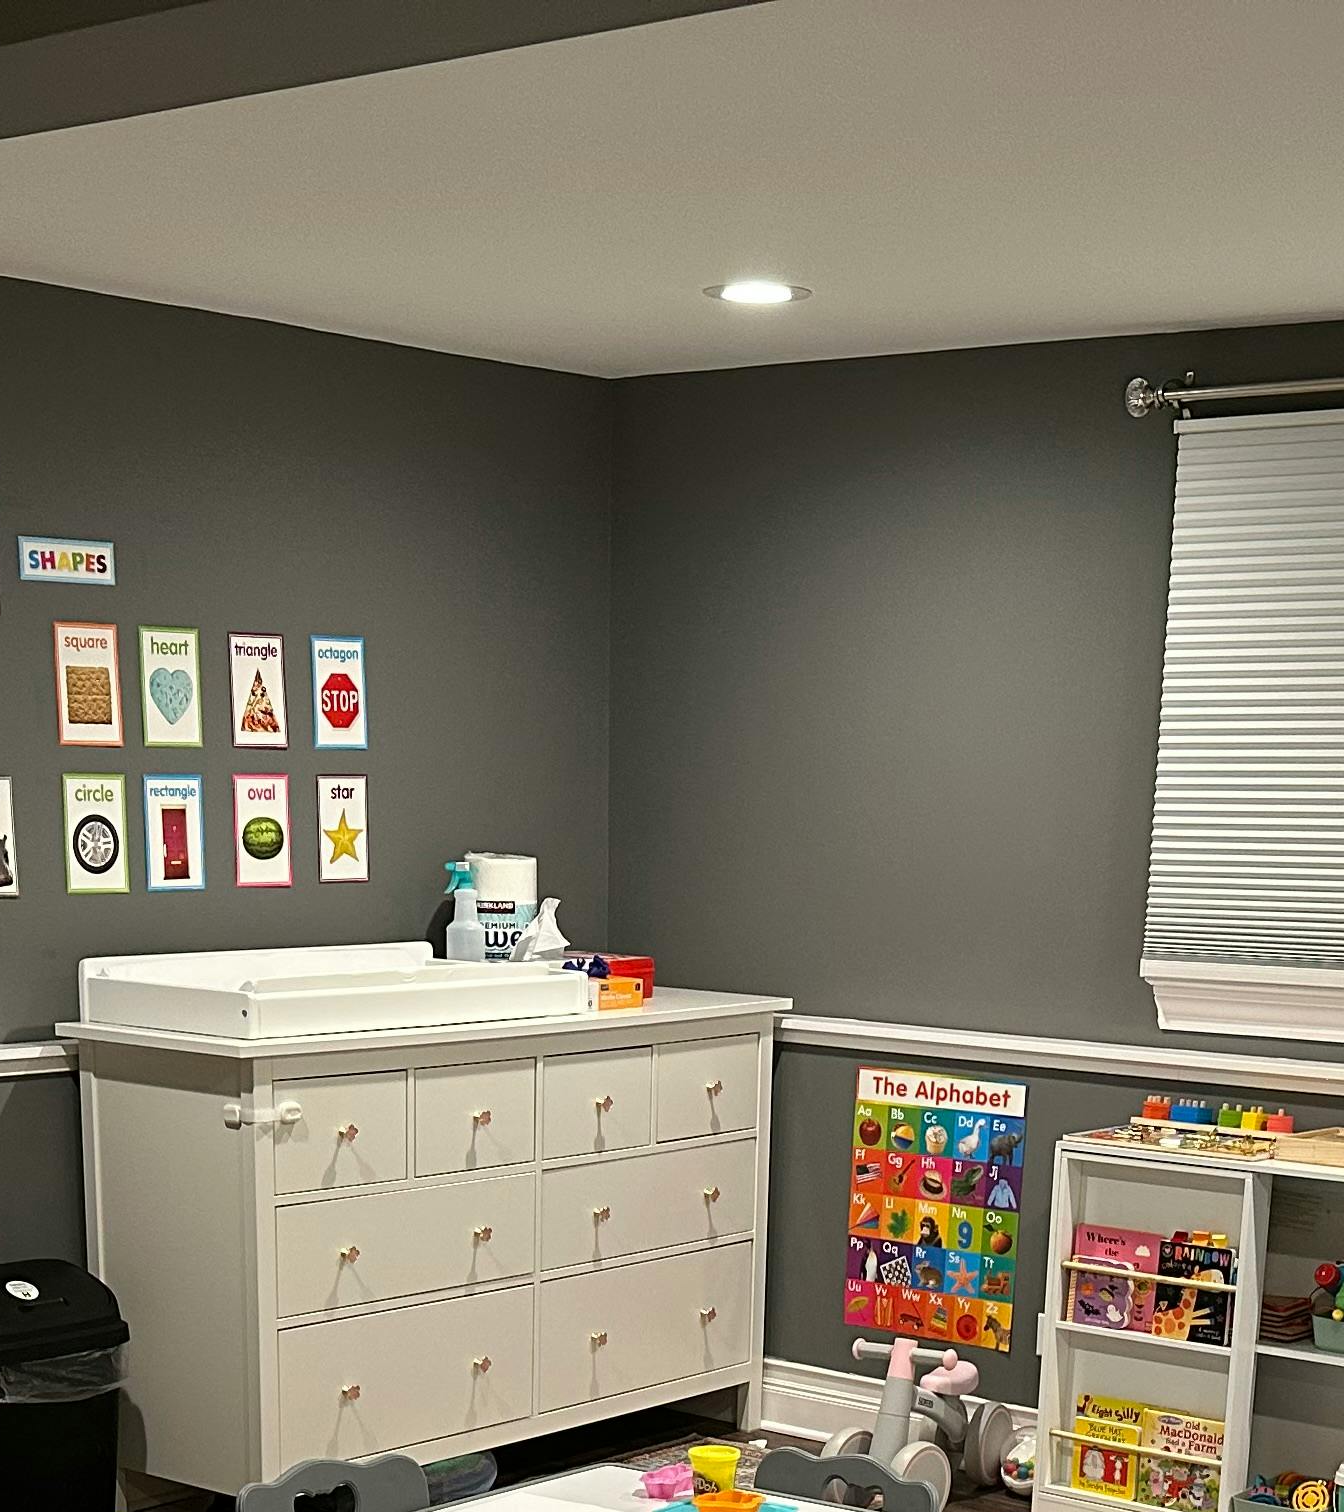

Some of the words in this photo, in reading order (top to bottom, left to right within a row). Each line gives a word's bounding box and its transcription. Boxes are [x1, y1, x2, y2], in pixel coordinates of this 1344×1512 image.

[28, 549, 107, 574] SHAPES
[64, 635, 108, 655] square
[150, 636, 189, 656] heart
[234, 642, 278, 662] triangle
[317, 646, 359, 664] octagon
[321, 689, 359, 713] STOP
[74, 784, 114, 802] circle
[149, 785, 197, 801] rectangle
[247, 784, 276, 801] oval
[330, 785, 355, 801] star
[873, 1076, 907, 1097] The
[915, 1080, 1011, 1107] Alphabet
[857, 1105, 872, 1117] Aa
[891, 1108, 904, 1120] Bb
[924, 1112, 937, 1124] Cc
[958, 1116, 973, 1127] Dd
[993, 1120, 1006, 1132] Ee
[888, 1153, 902, 1168] Gg
[922, 1157, 935, 1169] Hh
[989, 1166, 998, 1180] Jj
[852, 1192, 865, 1205] Kk
[918, 1204, 938, 1215] Mm
[952, 1207, 966, 1219] Nn
[986, 1212, 1002, 1224] Oo
[1085, 1231, 1126, 1247] Where's
[850, 1237, 863, 1250] Pp
[882, 1242, 898, 1257] Qq
[916, 1247, 927, 1258] Rr
[949, 1252, 960, 1263] Ss
[984, 1256, 994, 1268] Tt
[1104, 1247, 1120, 1257] the
[1174, 1245, 1231, 1267] RAINBOW
[848, 1280, 861, 1292] Uu
[875, 1285, 887, 1296] Vv
[901, 1290, 920, 1302] Ww
[929, 1294, 943, 1306] Xx
[958, 1298, 970, 1312] Yy
[986, 1304, 998, 1315] Zz
[1114, 1406, 1141, 1424] Silly
[1160, 1425, 1224, 1446] MacDonald
[1185, 1421, 1200, 1432] Old
[1188, 1440, 1217, 1455] Farm
